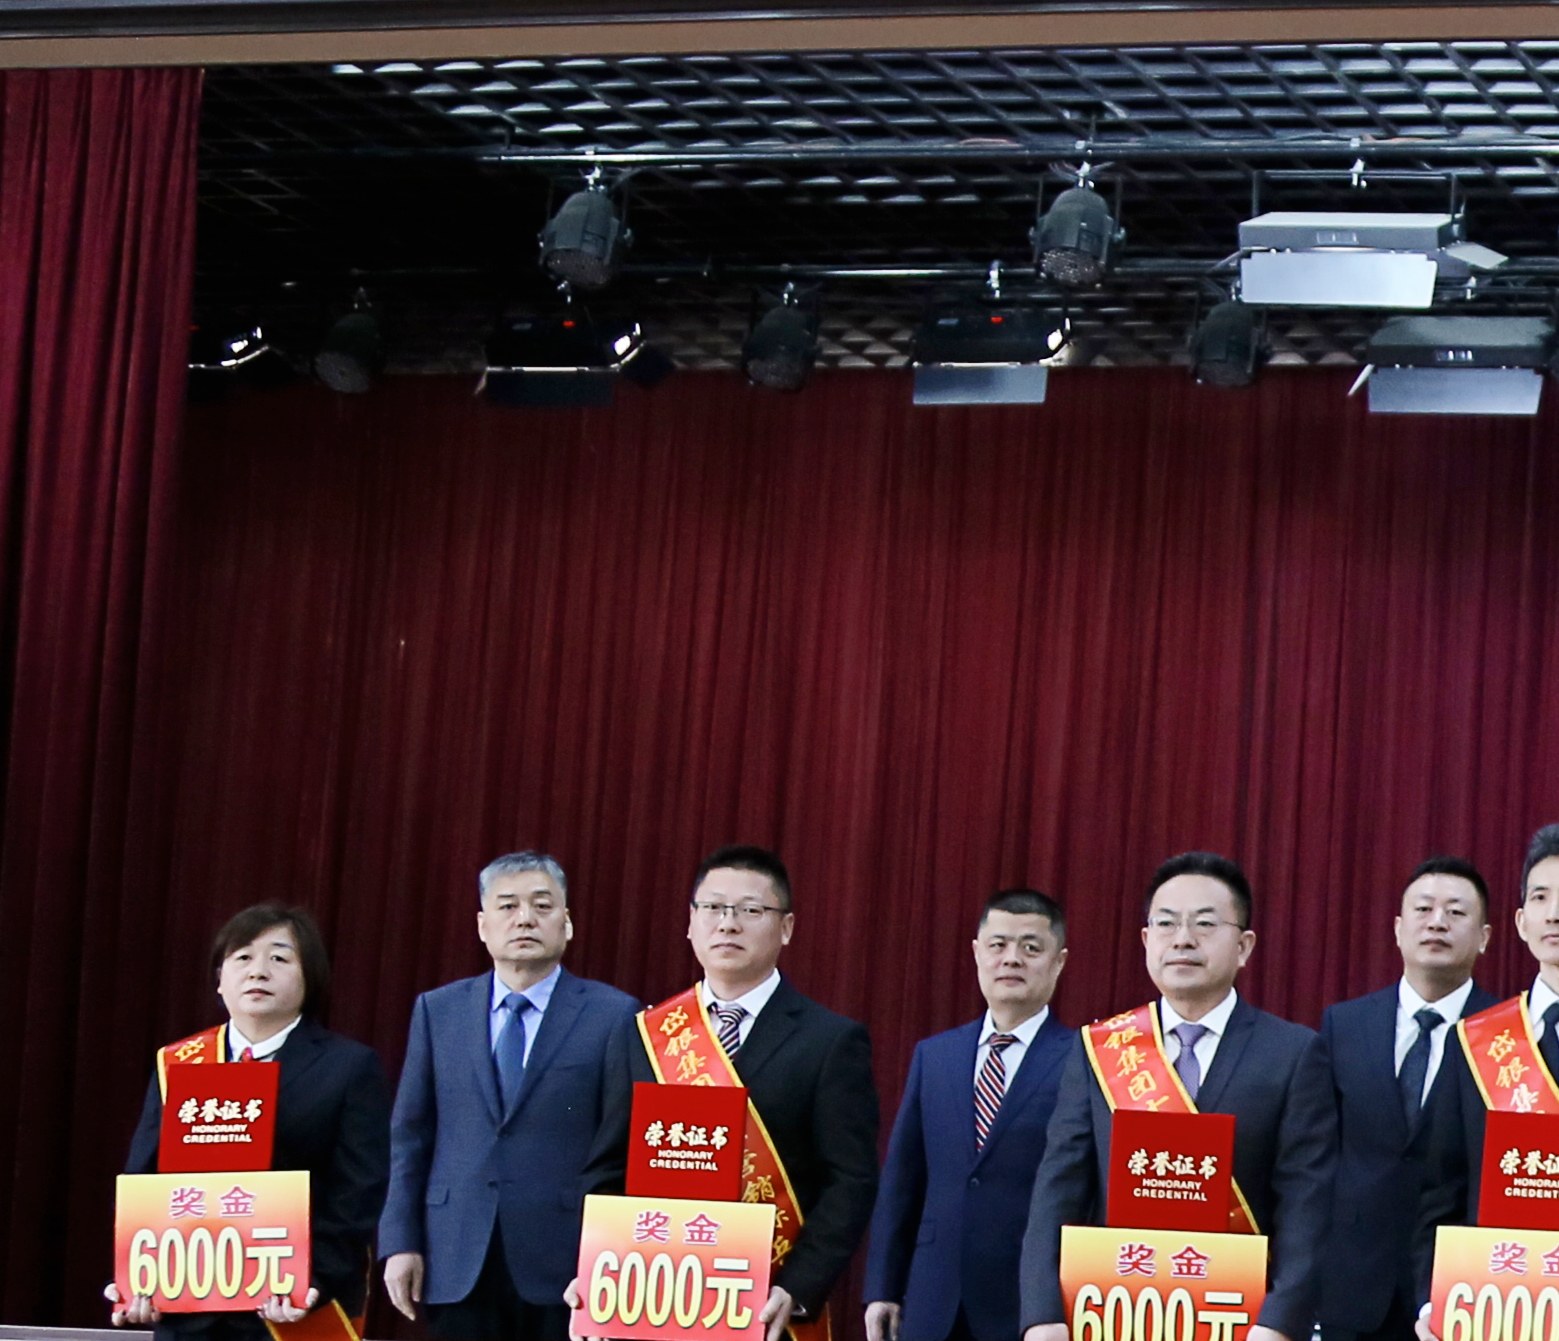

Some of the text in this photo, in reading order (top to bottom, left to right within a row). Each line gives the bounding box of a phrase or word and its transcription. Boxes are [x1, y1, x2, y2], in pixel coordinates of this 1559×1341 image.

[178, 1098, 263, 1123] 荣誉证书
[183, 1134, 252, 1143] CREDENTIAL
[192, 1124, 247, 1133] HONORARY
[644, 1120, 729, 1149] 荣誉证书
[649, 1159, 718, 1171] CREDENTIAL
[658, 1150, 713, 1160] HONORARY
[1127, 1148, 1218, 1180] 荣誉证书
[1133, 1188, 1207, 1201] CREDENTIAL
[1142, 1178, 1201, 1189] HONORARY
[169, 1185, 256, 1219] 奖金
[634, 1211, 722, 1245] 奖金
[129, 1226, 295, 1299] 6000元
[1115, 1244, 1210, 1278] 奖金
[588, 1251, 753, 1330] 6000元
